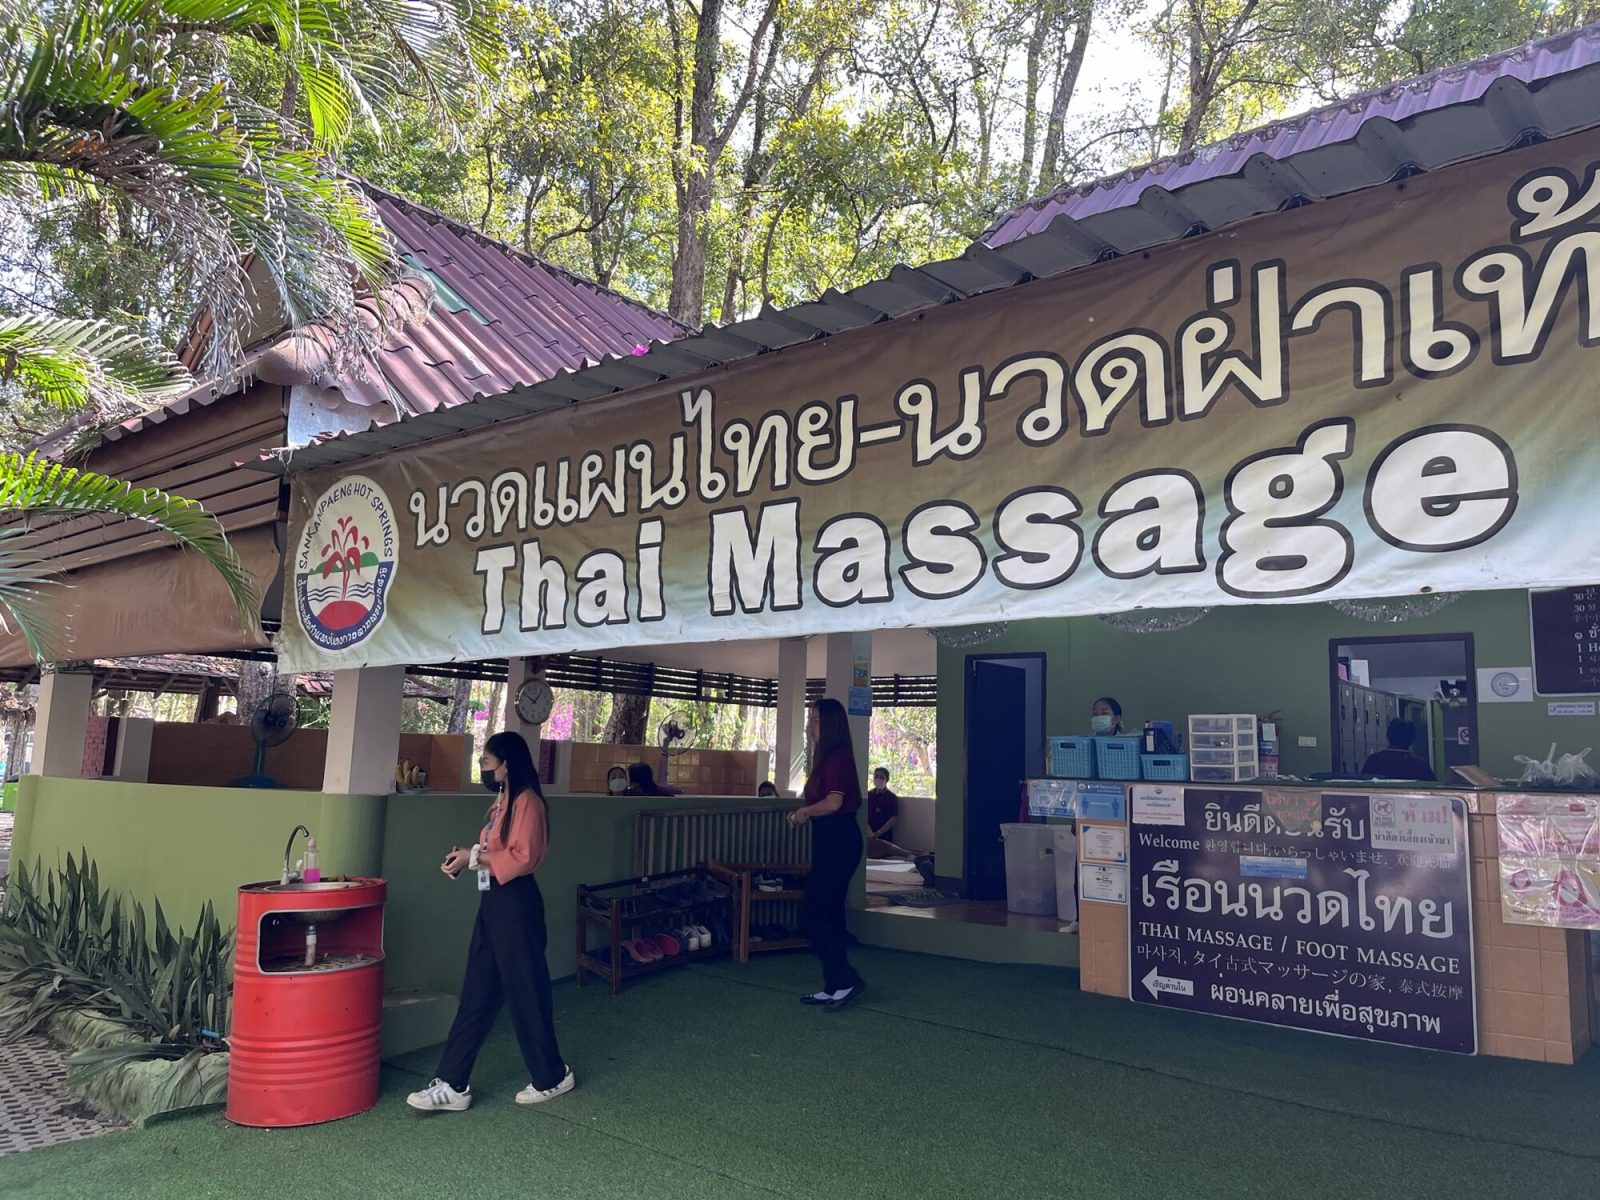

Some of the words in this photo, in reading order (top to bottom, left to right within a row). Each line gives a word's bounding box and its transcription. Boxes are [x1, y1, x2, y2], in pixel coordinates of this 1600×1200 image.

[353, 482, 374, 501] HOT
[370, 497, 394, 558] SPRINGS
[475, 518, 665, 636] Thai
[708, 417, 1518, 616] Massage
[1138, 832, 1201, 851] Welcome
[1141, 859, 1455, 940] เรือนนวดไทย
[1139, 921, 1180, 940] THAI
[1187, 927, 1273, 952] MASSAGE
[1280, 935, 1288, 953] /
[1296, 940, 1349, 961] FOOT
[1357, 947, 1460, 975] MASSAGE
[1210, 972, 1442, 1035] ผ่อนคลายเพื่อสุขภาพ
